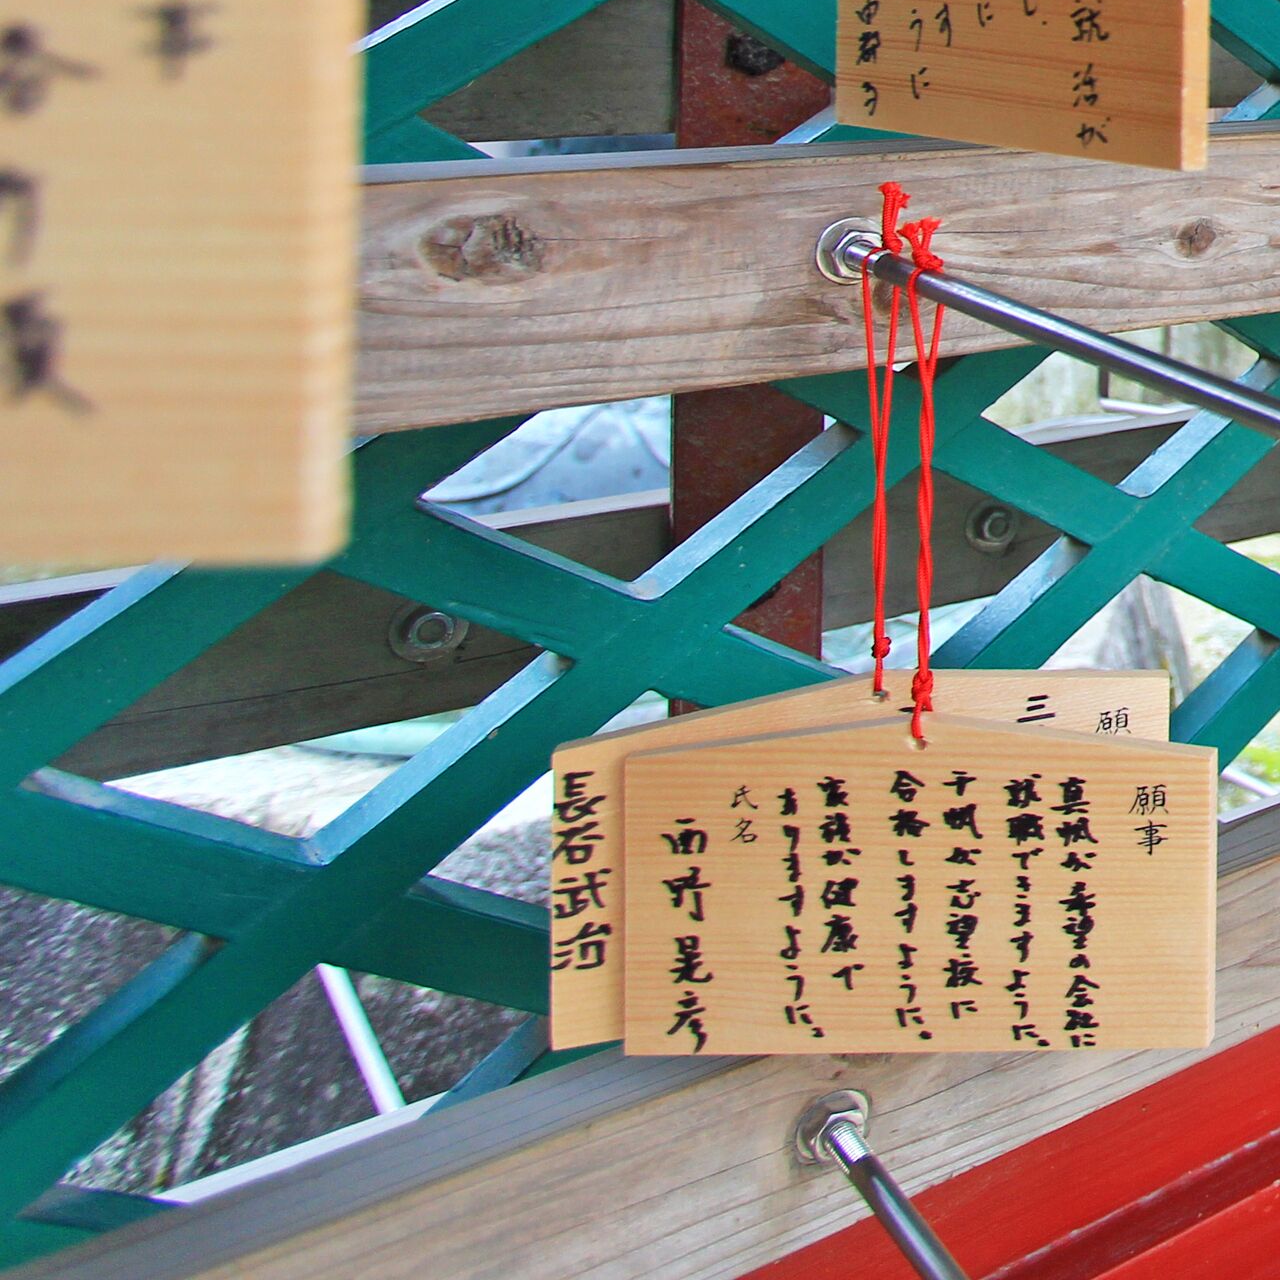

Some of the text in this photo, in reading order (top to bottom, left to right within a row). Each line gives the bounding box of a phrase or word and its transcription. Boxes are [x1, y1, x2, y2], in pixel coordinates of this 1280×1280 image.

[730, 785, 760, 845] 氏名
[817, 775, 866, 992] 家族が健康で
[888, 770, 933, 1042] 合格しますように。
[1002, 773, 1051, 1048] 就職できますように。
[1050, 776, 1100, 1049] 真帆が希望の会社に
[1128, 783, 1170, 856] 願事
